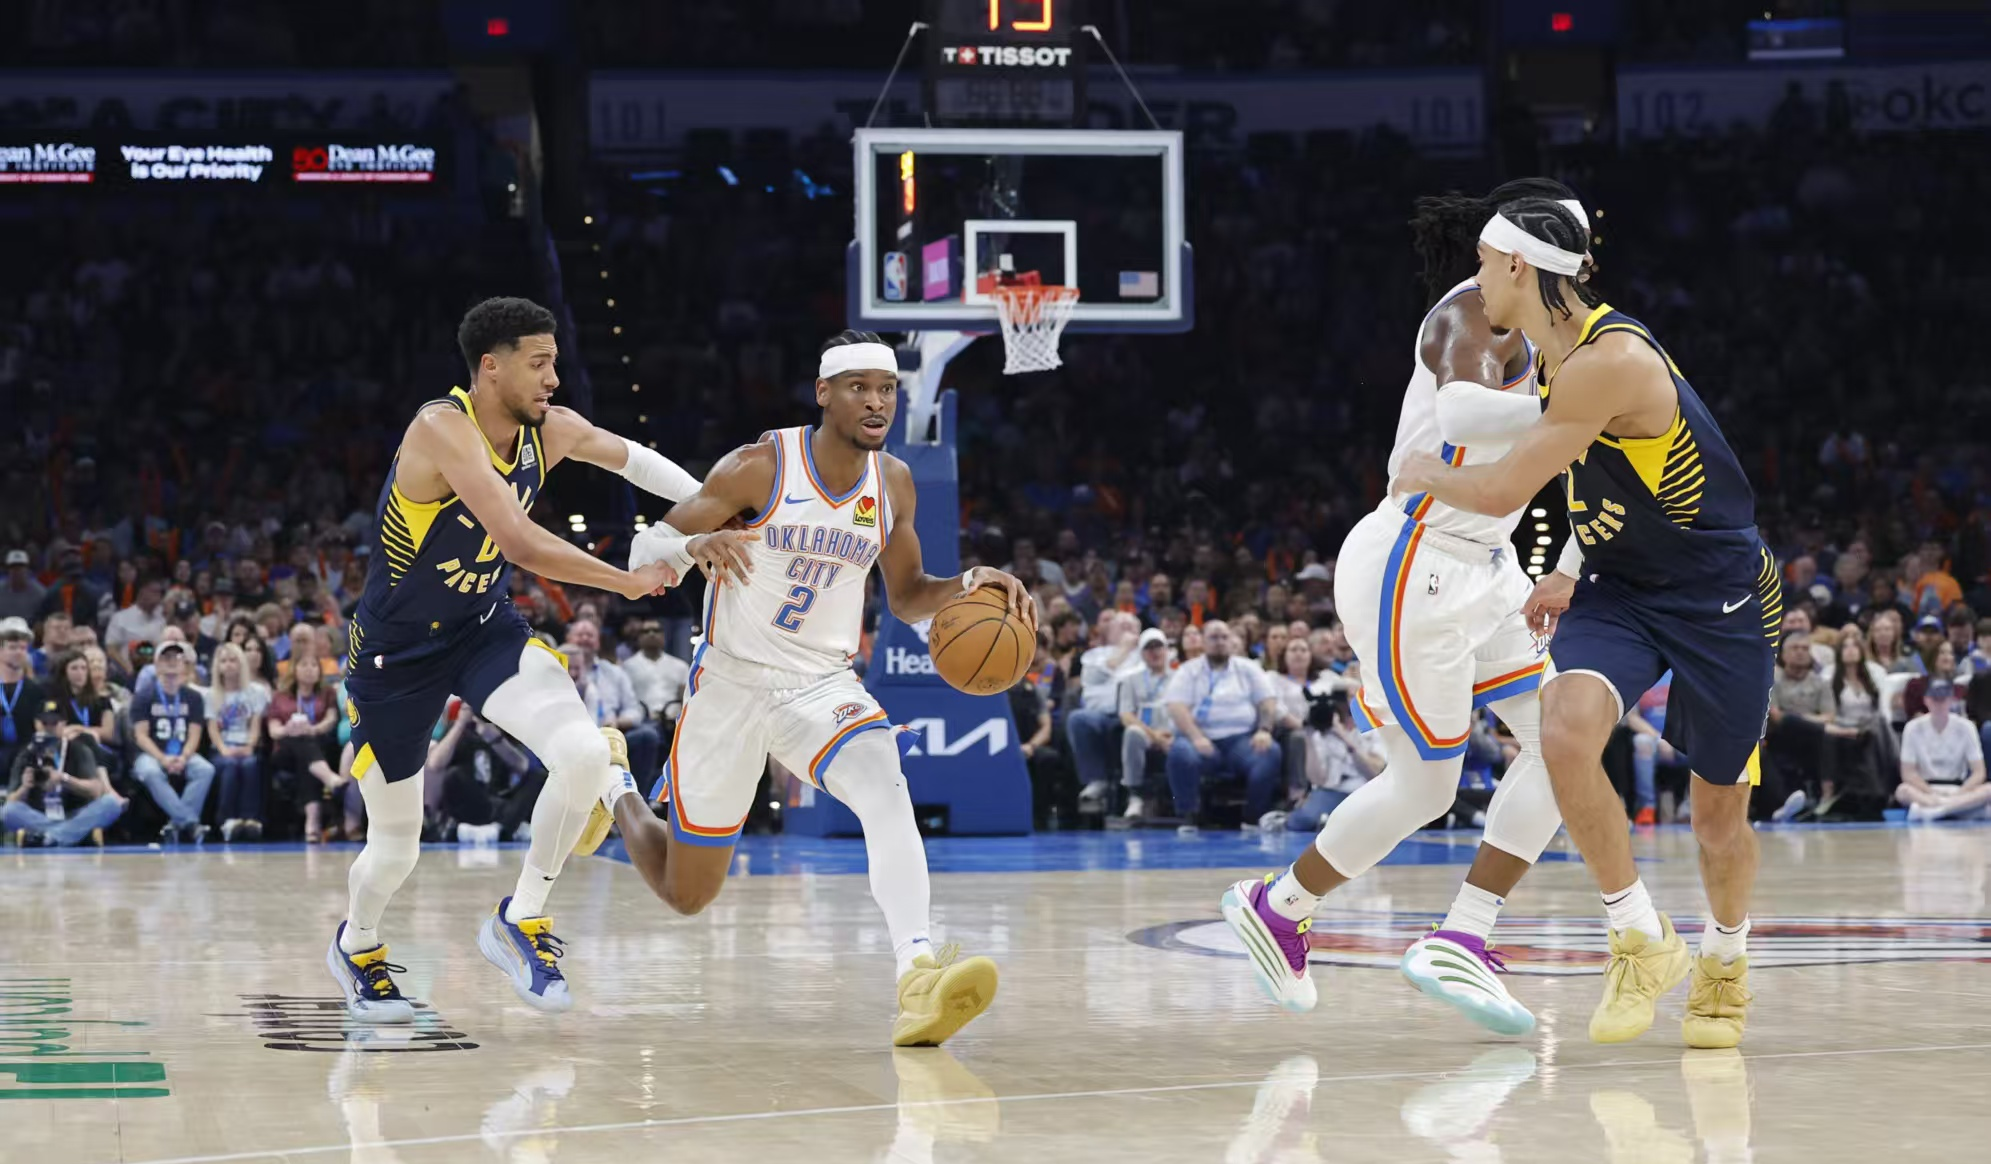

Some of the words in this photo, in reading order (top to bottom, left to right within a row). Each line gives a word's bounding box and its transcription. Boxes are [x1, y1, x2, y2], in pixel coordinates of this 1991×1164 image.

[978, 46, 1072, 66] TISSOT
[120, 145, 166, 161] Your
[167, 145, 205, 164] Eye
[206, 145, 273, 162] Health
[328, 144, 376, 162] Dean
[378, 144, 435, 162] McGee
[150, 162, 188, 179] Our
[189, 162, 263, 182] Priority
[765, 523, 881, 570] OKLAHOMA
[786, 556, 843, 590] CITY
[771, 584, 818, 634] 2
